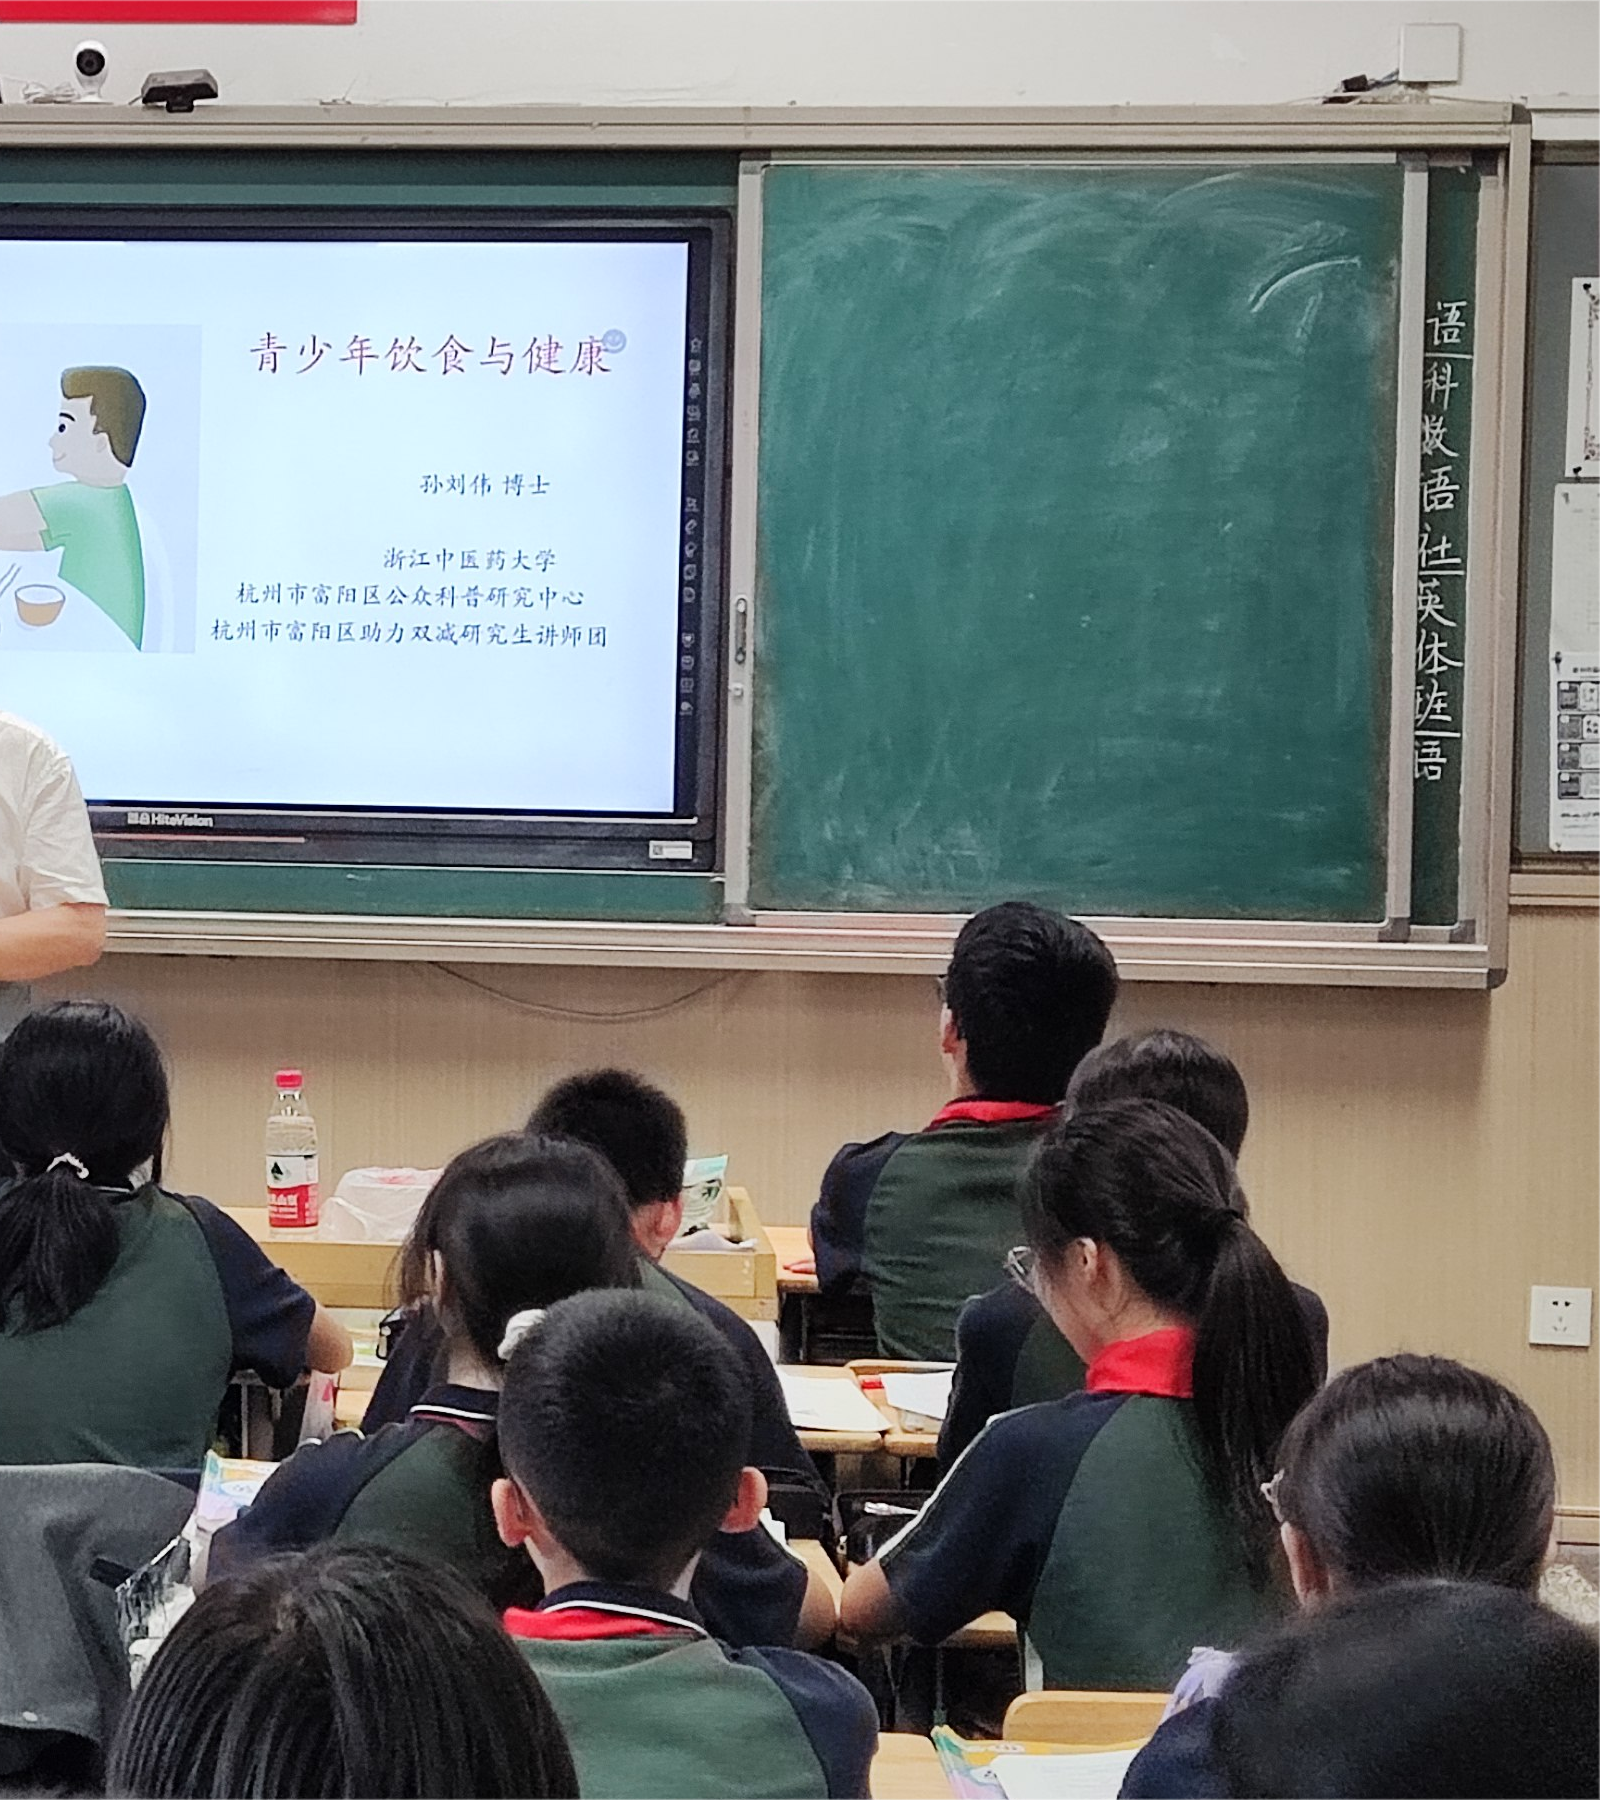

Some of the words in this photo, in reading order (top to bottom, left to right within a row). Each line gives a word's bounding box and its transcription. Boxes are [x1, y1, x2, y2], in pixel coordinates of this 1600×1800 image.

[250, 331, 612, 377] 青少年饮食与健康
[419, 473, 492, 497] 孙刘伟
[502, 473, 551, 497] 博士
[383, 547, 558, 573] 浙江中医药大学
[236, 581, 584, 611] 杭州市富阳区公众科普研究中心
[211, 618, 607, 648] 杭州市富阳区助力双减研究生讲师团
